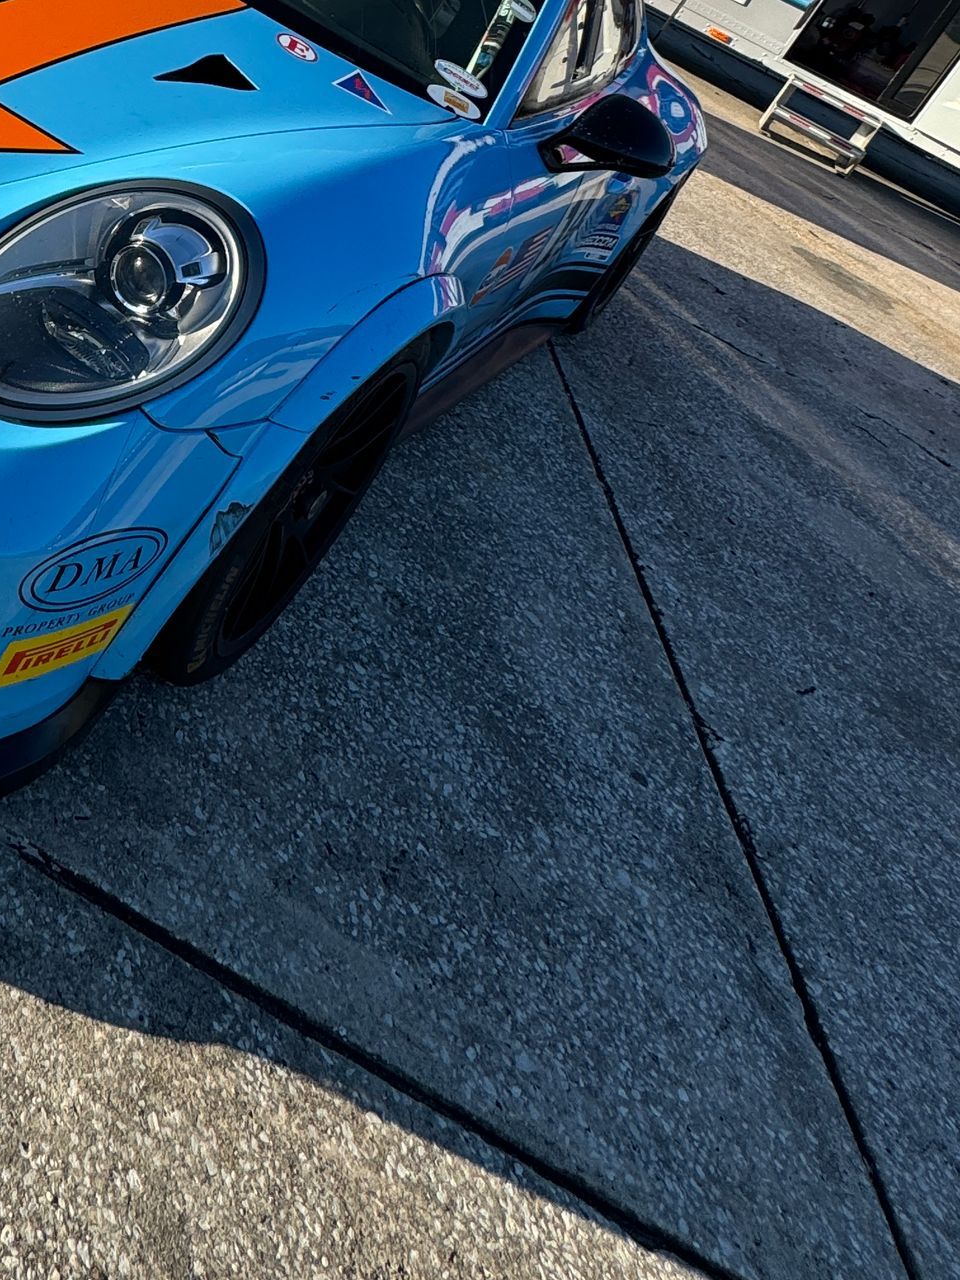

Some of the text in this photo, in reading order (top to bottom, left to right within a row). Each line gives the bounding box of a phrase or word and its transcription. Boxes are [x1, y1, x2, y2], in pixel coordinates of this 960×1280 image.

[44, 545, 144, 594] DMA
[1, 591, 136, 638] PROPERTY GROUP
[2, 618, 119, 677] PIRELLI
